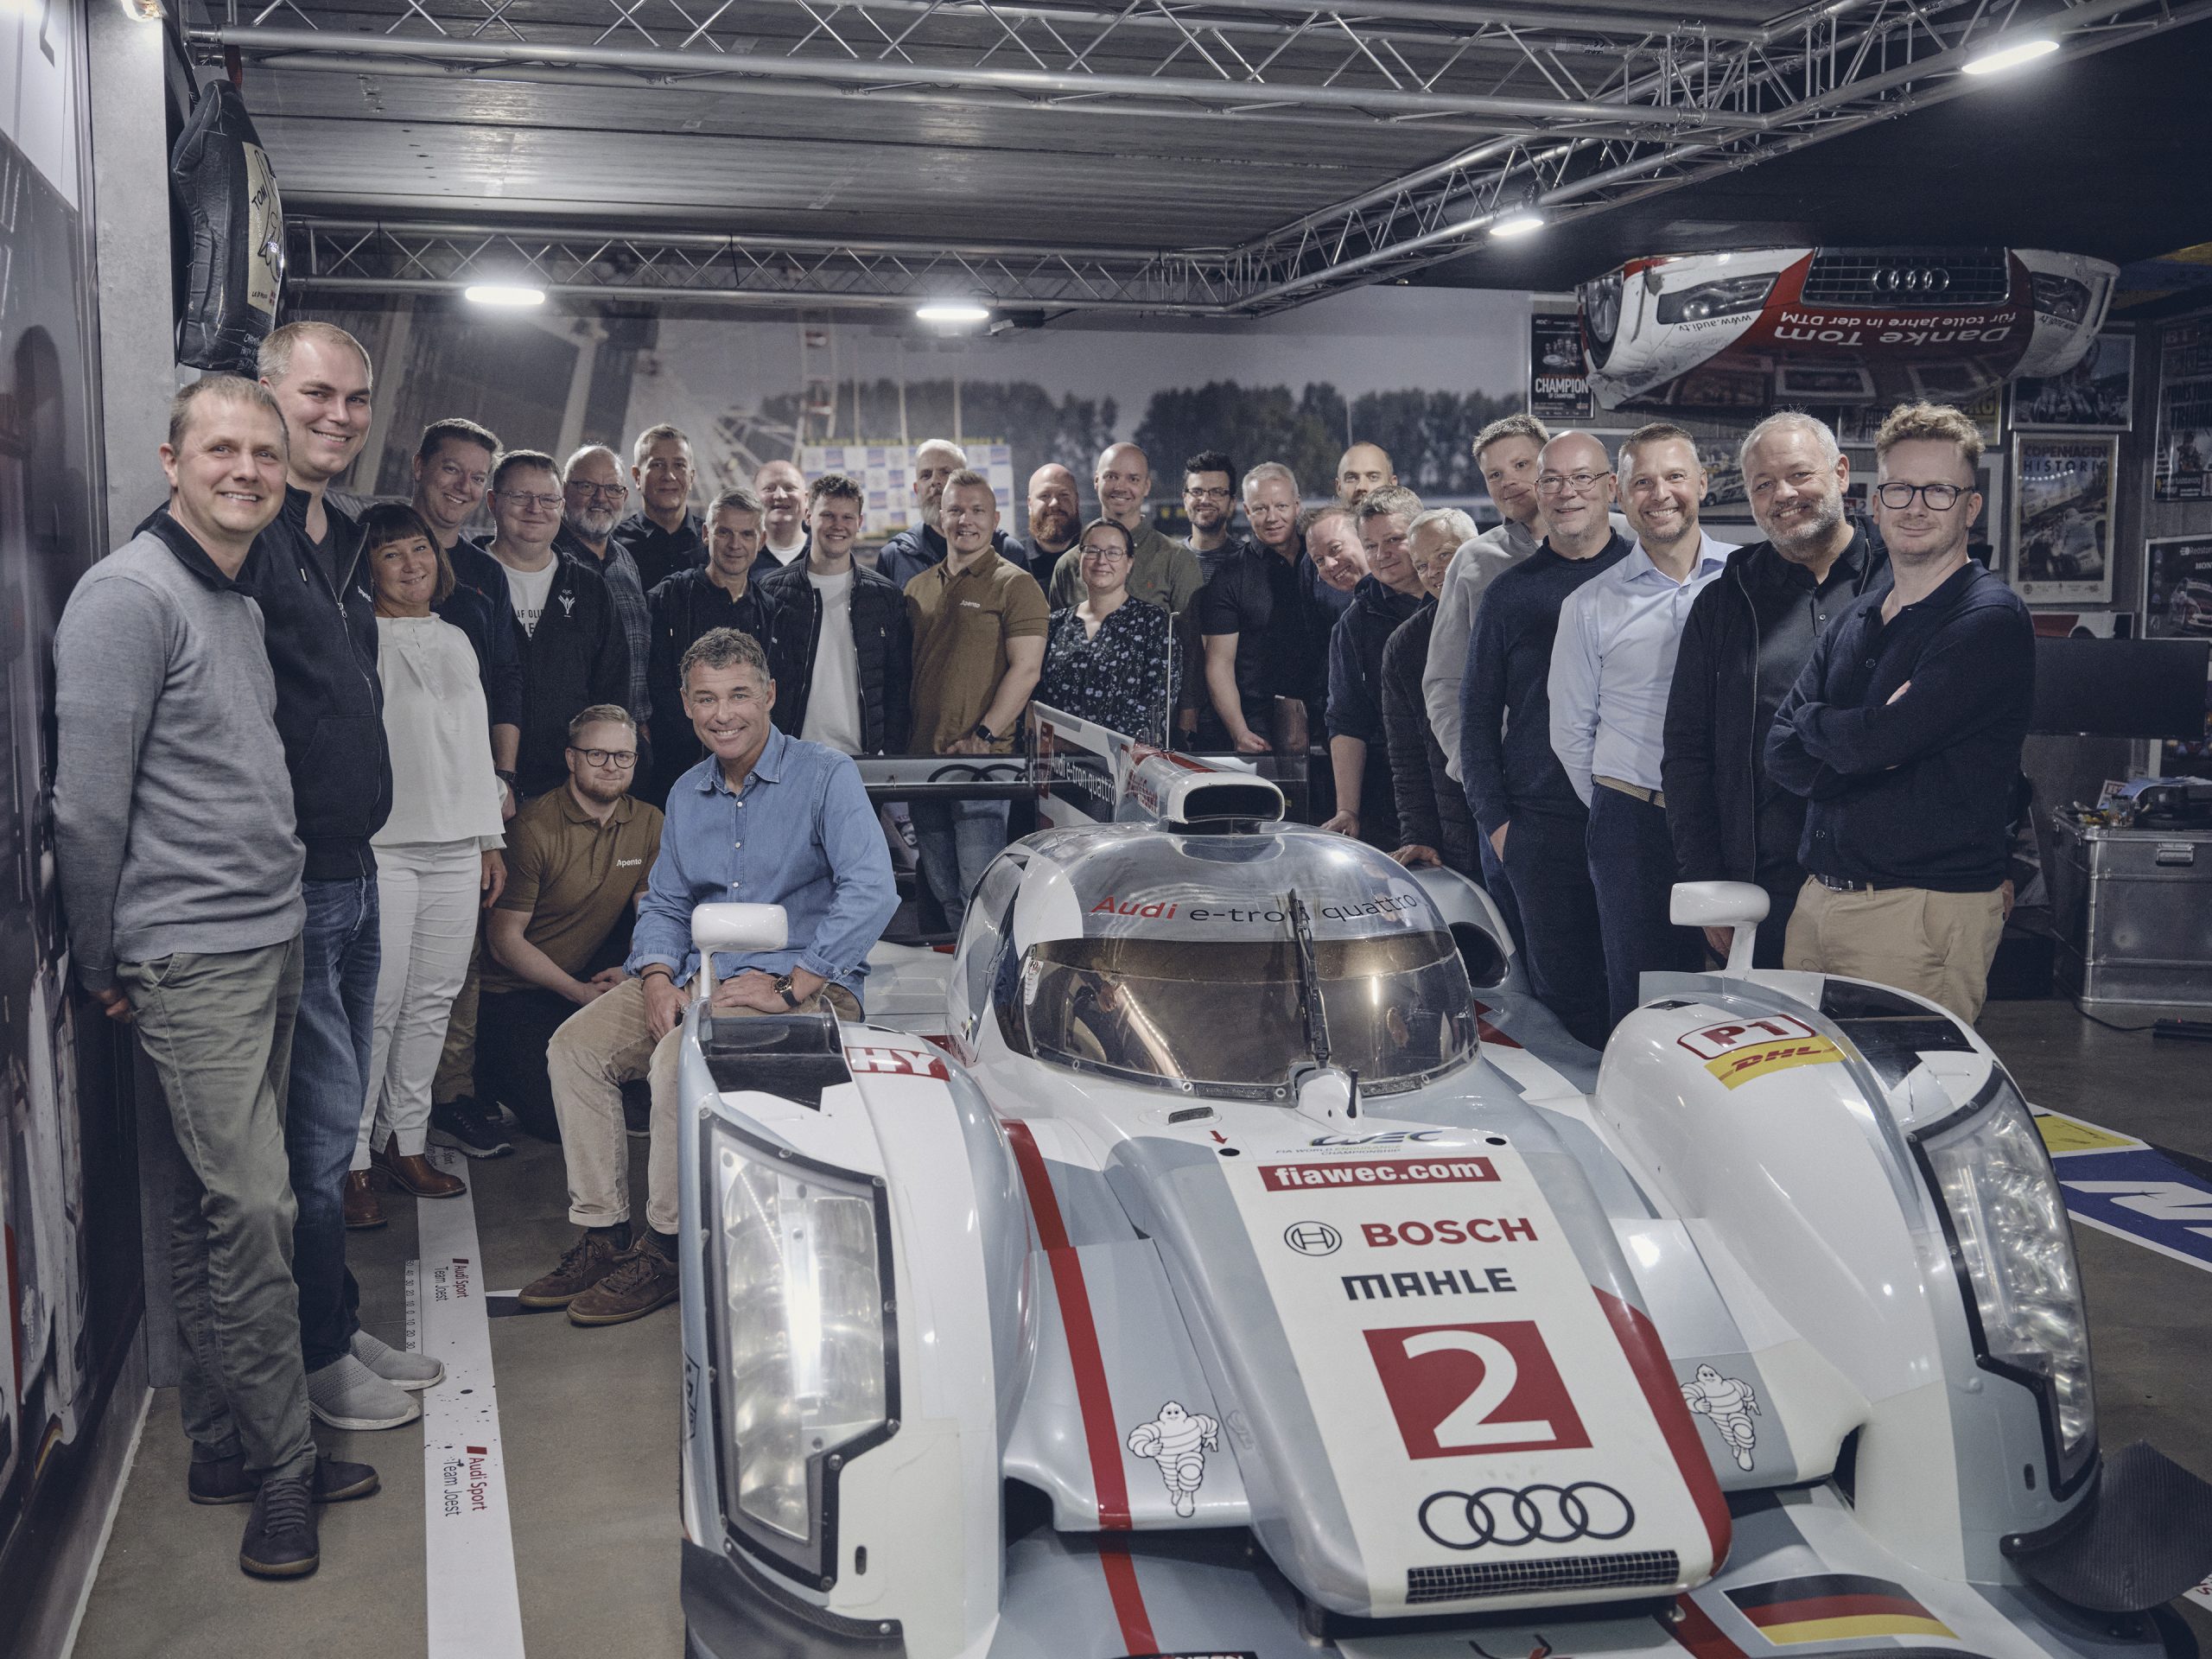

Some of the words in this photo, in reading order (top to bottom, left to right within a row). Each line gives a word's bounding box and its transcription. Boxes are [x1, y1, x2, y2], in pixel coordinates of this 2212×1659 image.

[252, 185, 269, 212] TOM
[1678, 314, 1752, 333] www.audi.tv
[1780, 311, 1825, 326] DTM
[1827, 315, 1861, 326] der
[1866, 317, 1883, 327] in
[1888, 317, 1936, 327] Jahre
[1942, 315, 1985, 326] tolle
[1990, 311, 2017, 324] für
[1773, 326, 1863, 346] Tom
[1878, 326, 2012, 346] Danke
[2024, 446, 2108, 458] COPENHAGEN
[1051, 753, 1066, 779] Audi
[1065, 760, 1087, 789] e-tron
[1088, 771, 1116, 806] quattro
[616, 858, 642, 868] Apento
[1091, 896, 1178, 919] Audi
[1321, 893, 1418, 923] quattro
[1700, 1020, 1790, 1048] P1
[848, 1048, 938, 1076] HY
[1731, 1046, 1821, 1072] DHL
[1310, 1130, 1442, 1147] WEC
[1274, 1162, 1485, 1186] fiawec.com
[1360, 1217, 1540, 1248] BOSCH
[435, 1266, 449, 1284] Team
[454, 1265, 469, 1280] Audi
[435, 1284, 450, 1302] Joest
[452, 1280, 469, 1299] Sport
[1341, 1268, 1518, 1300] MAHLE
[406, 1341, 416, 1350] 30
[1402, 1329, 1557, 1449] 2
[443, 1459, 461, 1486] Team
[469, 1457, 488, 1480] Audi
[443, 1489, 463, 1517] Joest
[467, 1481, 488, 1511] Sport
